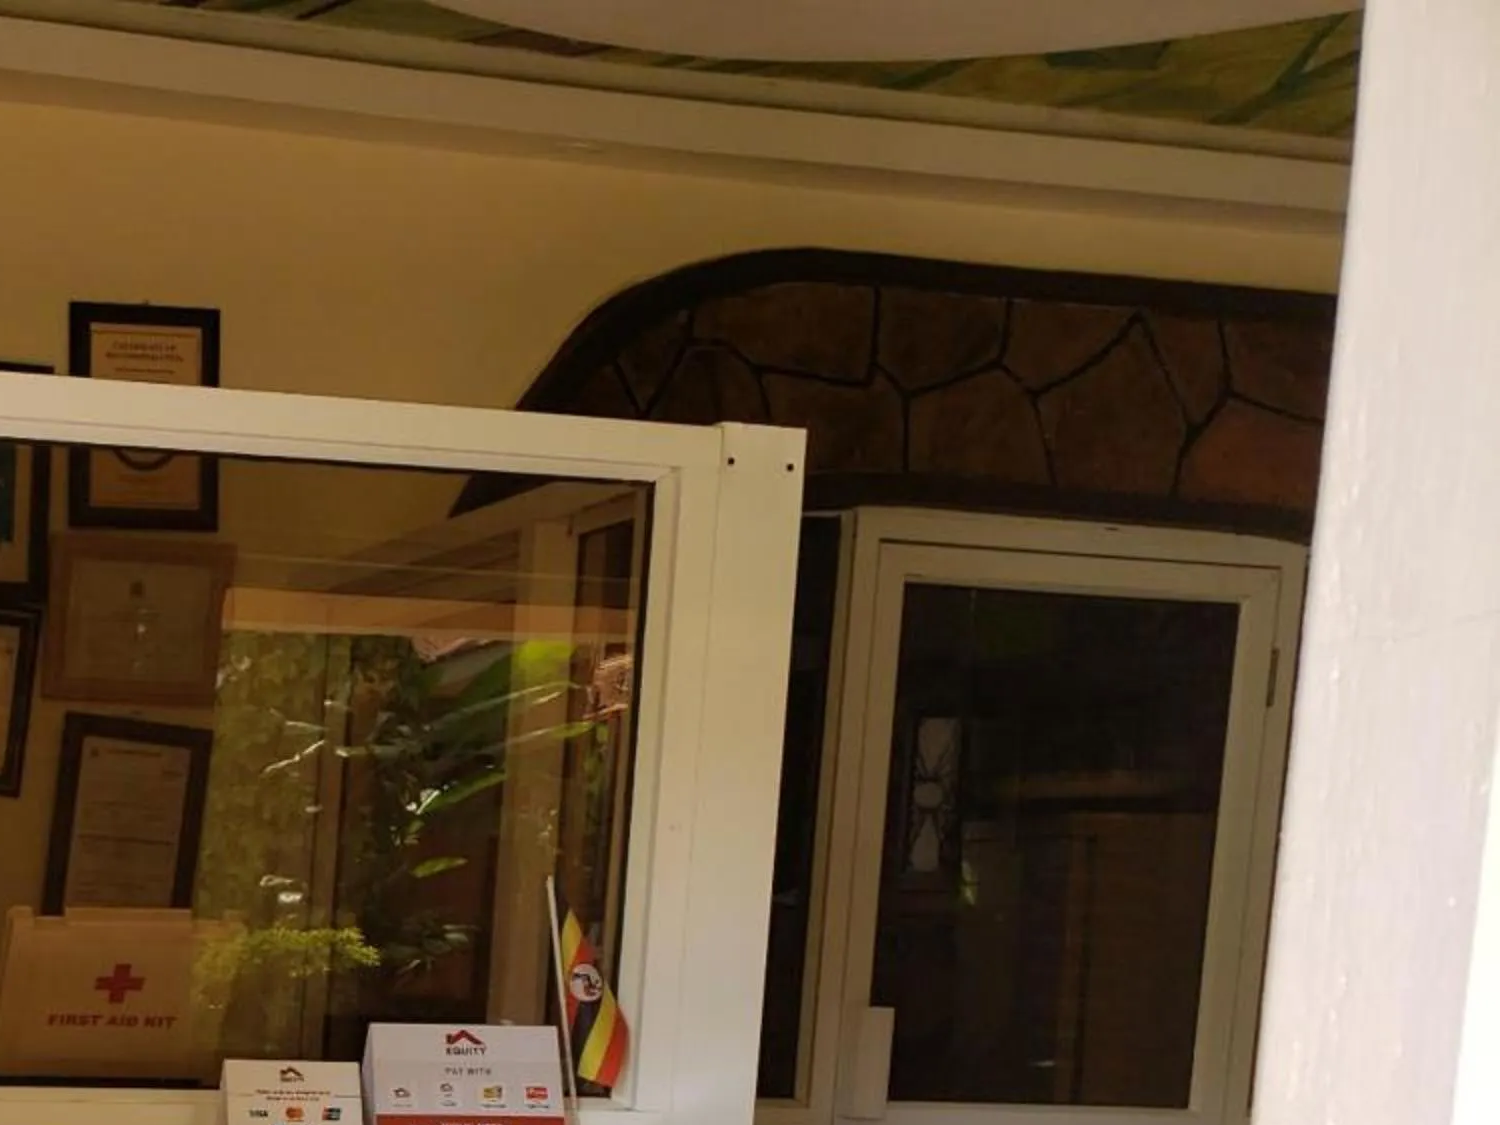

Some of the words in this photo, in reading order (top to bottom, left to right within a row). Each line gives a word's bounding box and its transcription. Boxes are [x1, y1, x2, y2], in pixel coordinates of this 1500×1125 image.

[47, 1013, 102, 1027] FIRST
[105, 1014, 138, 1027] AID
[143, 1015, 177, 1029] KIT
[446, 1046, 487, 1056] EQUITY
